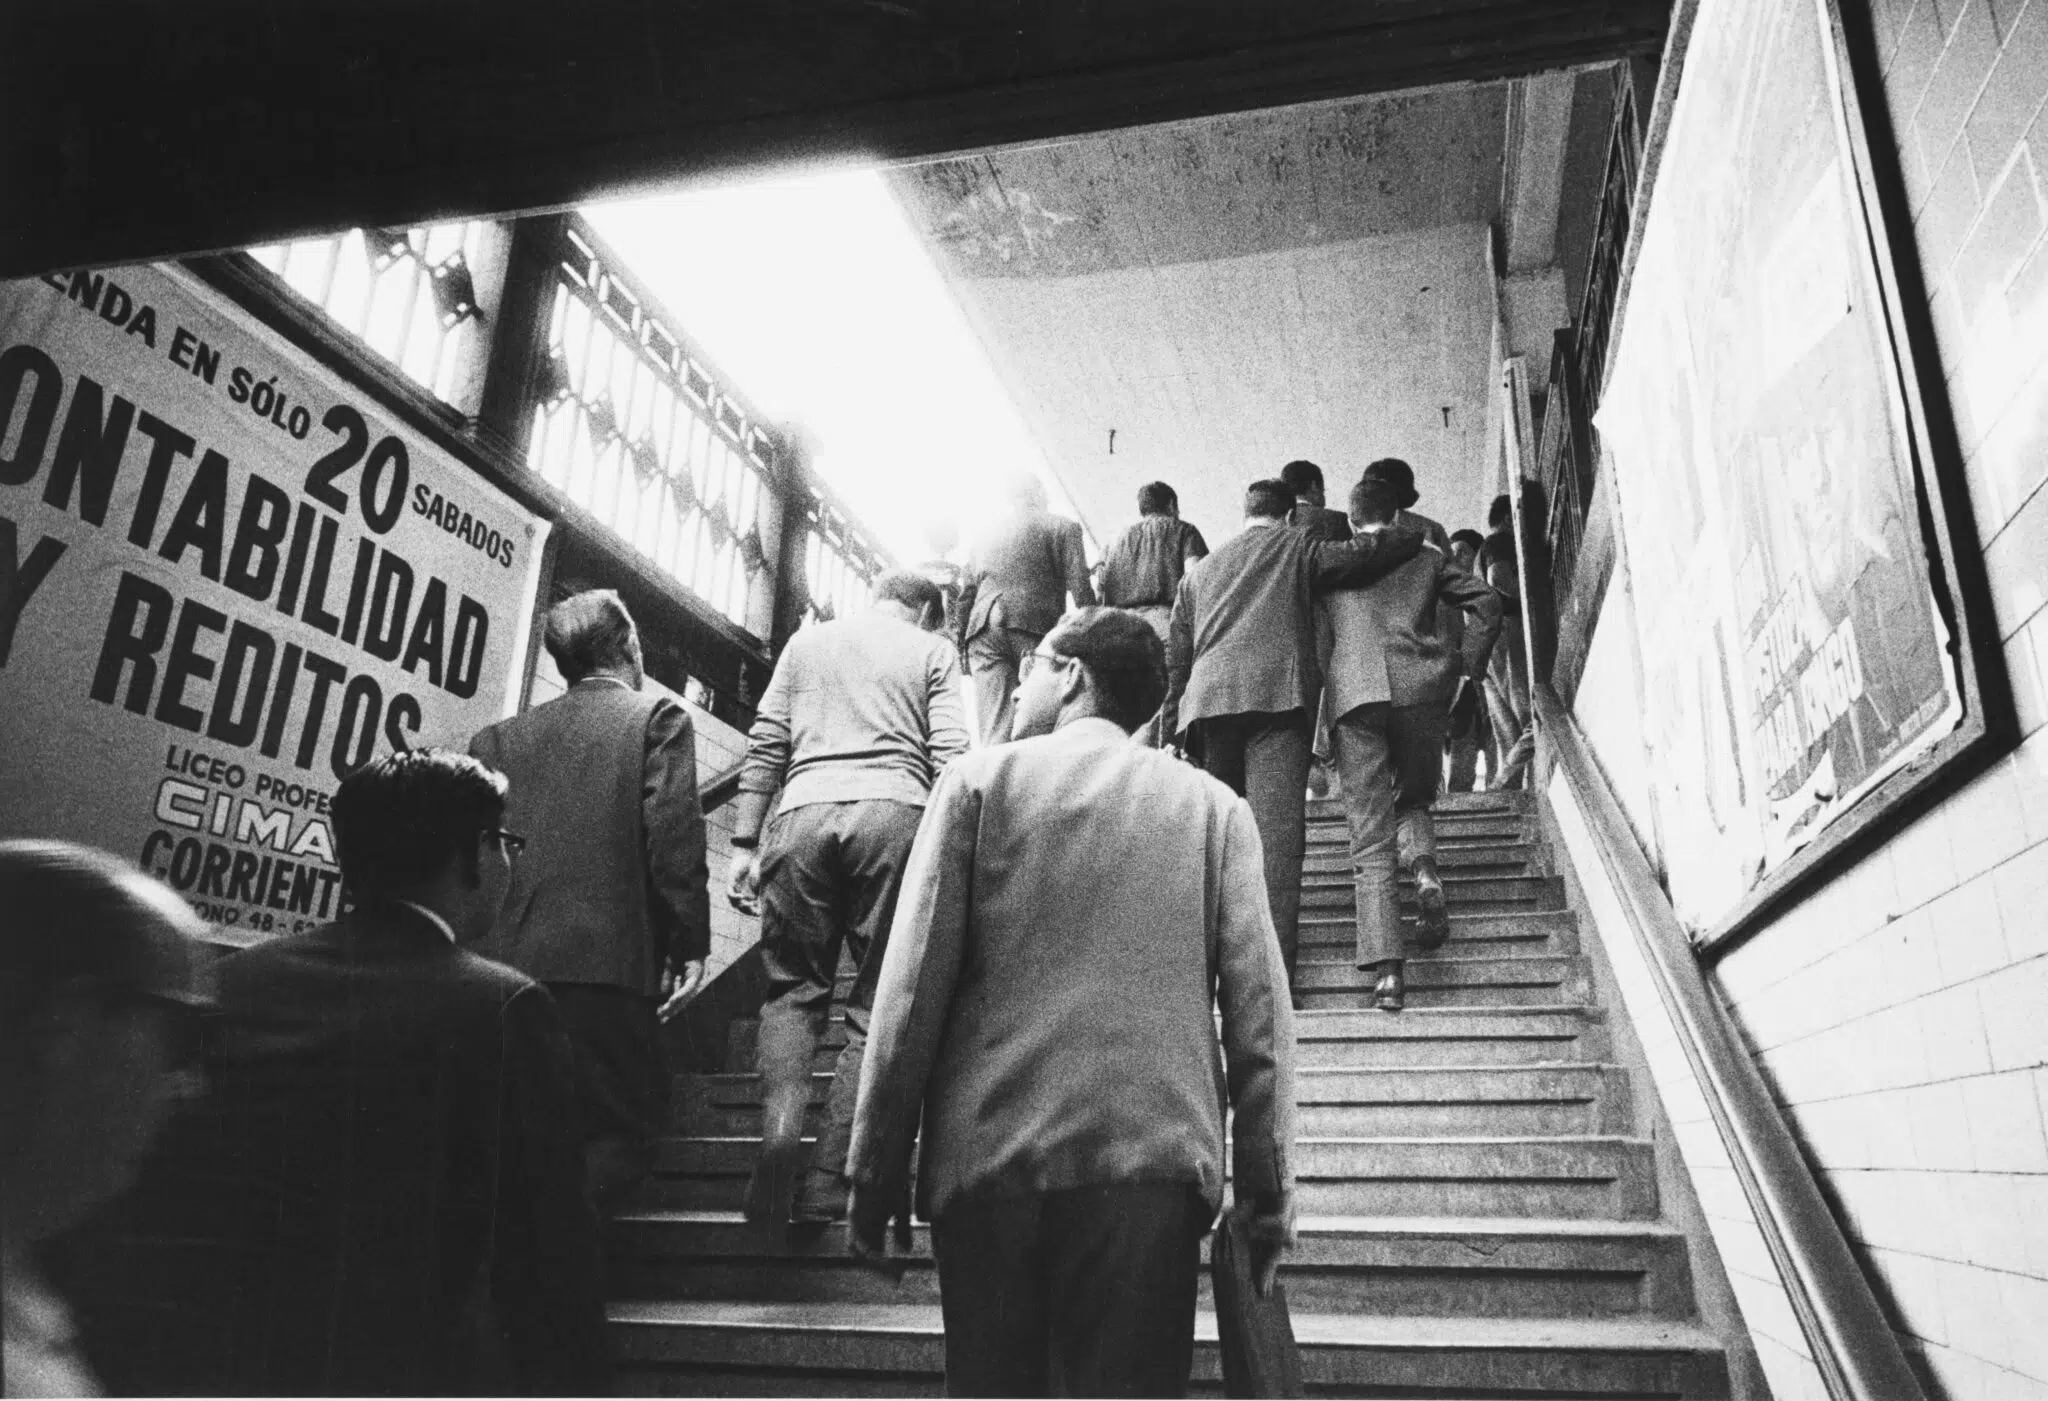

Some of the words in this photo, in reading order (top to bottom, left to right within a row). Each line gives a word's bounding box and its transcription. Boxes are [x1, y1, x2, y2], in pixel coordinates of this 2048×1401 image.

[0, 344, 488, 699] ONTABILIDAD
[168, 327, 220, 384] EN
[228, 376, 311, 440] SÓLO
[304, 404, 410, 535] 20
[411, 482, 515, 568] SABADOS
[90, 570, 422, 782] REDITOS
[165, 745, 245, 789] LICEO
[154, 775, 341, 868] CIMA
